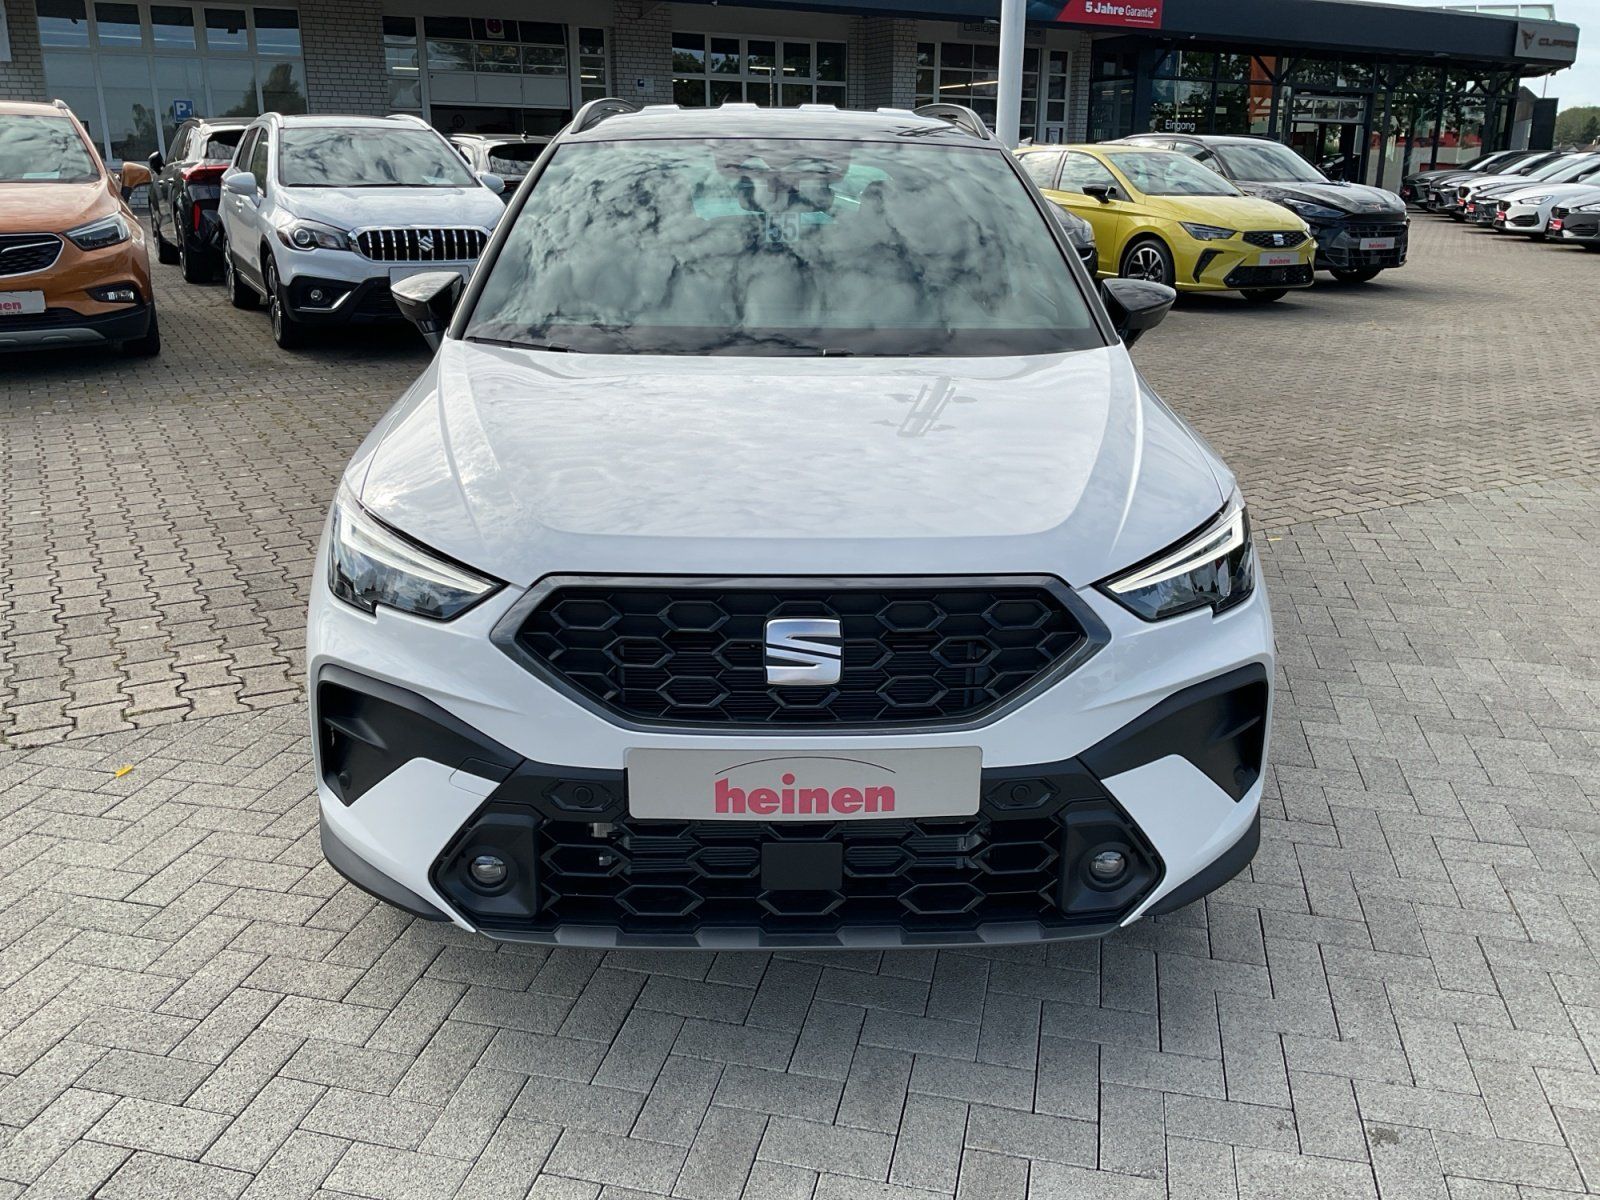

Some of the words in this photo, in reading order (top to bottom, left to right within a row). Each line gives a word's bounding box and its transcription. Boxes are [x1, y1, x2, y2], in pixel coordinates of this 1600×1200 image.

[1085, 1, 1092, 13] 5
[1094, 3, 1124, 15] Jahre
[1165, 119, 1195, 132] Eingang
[715, 773, 896, 815] heinen
